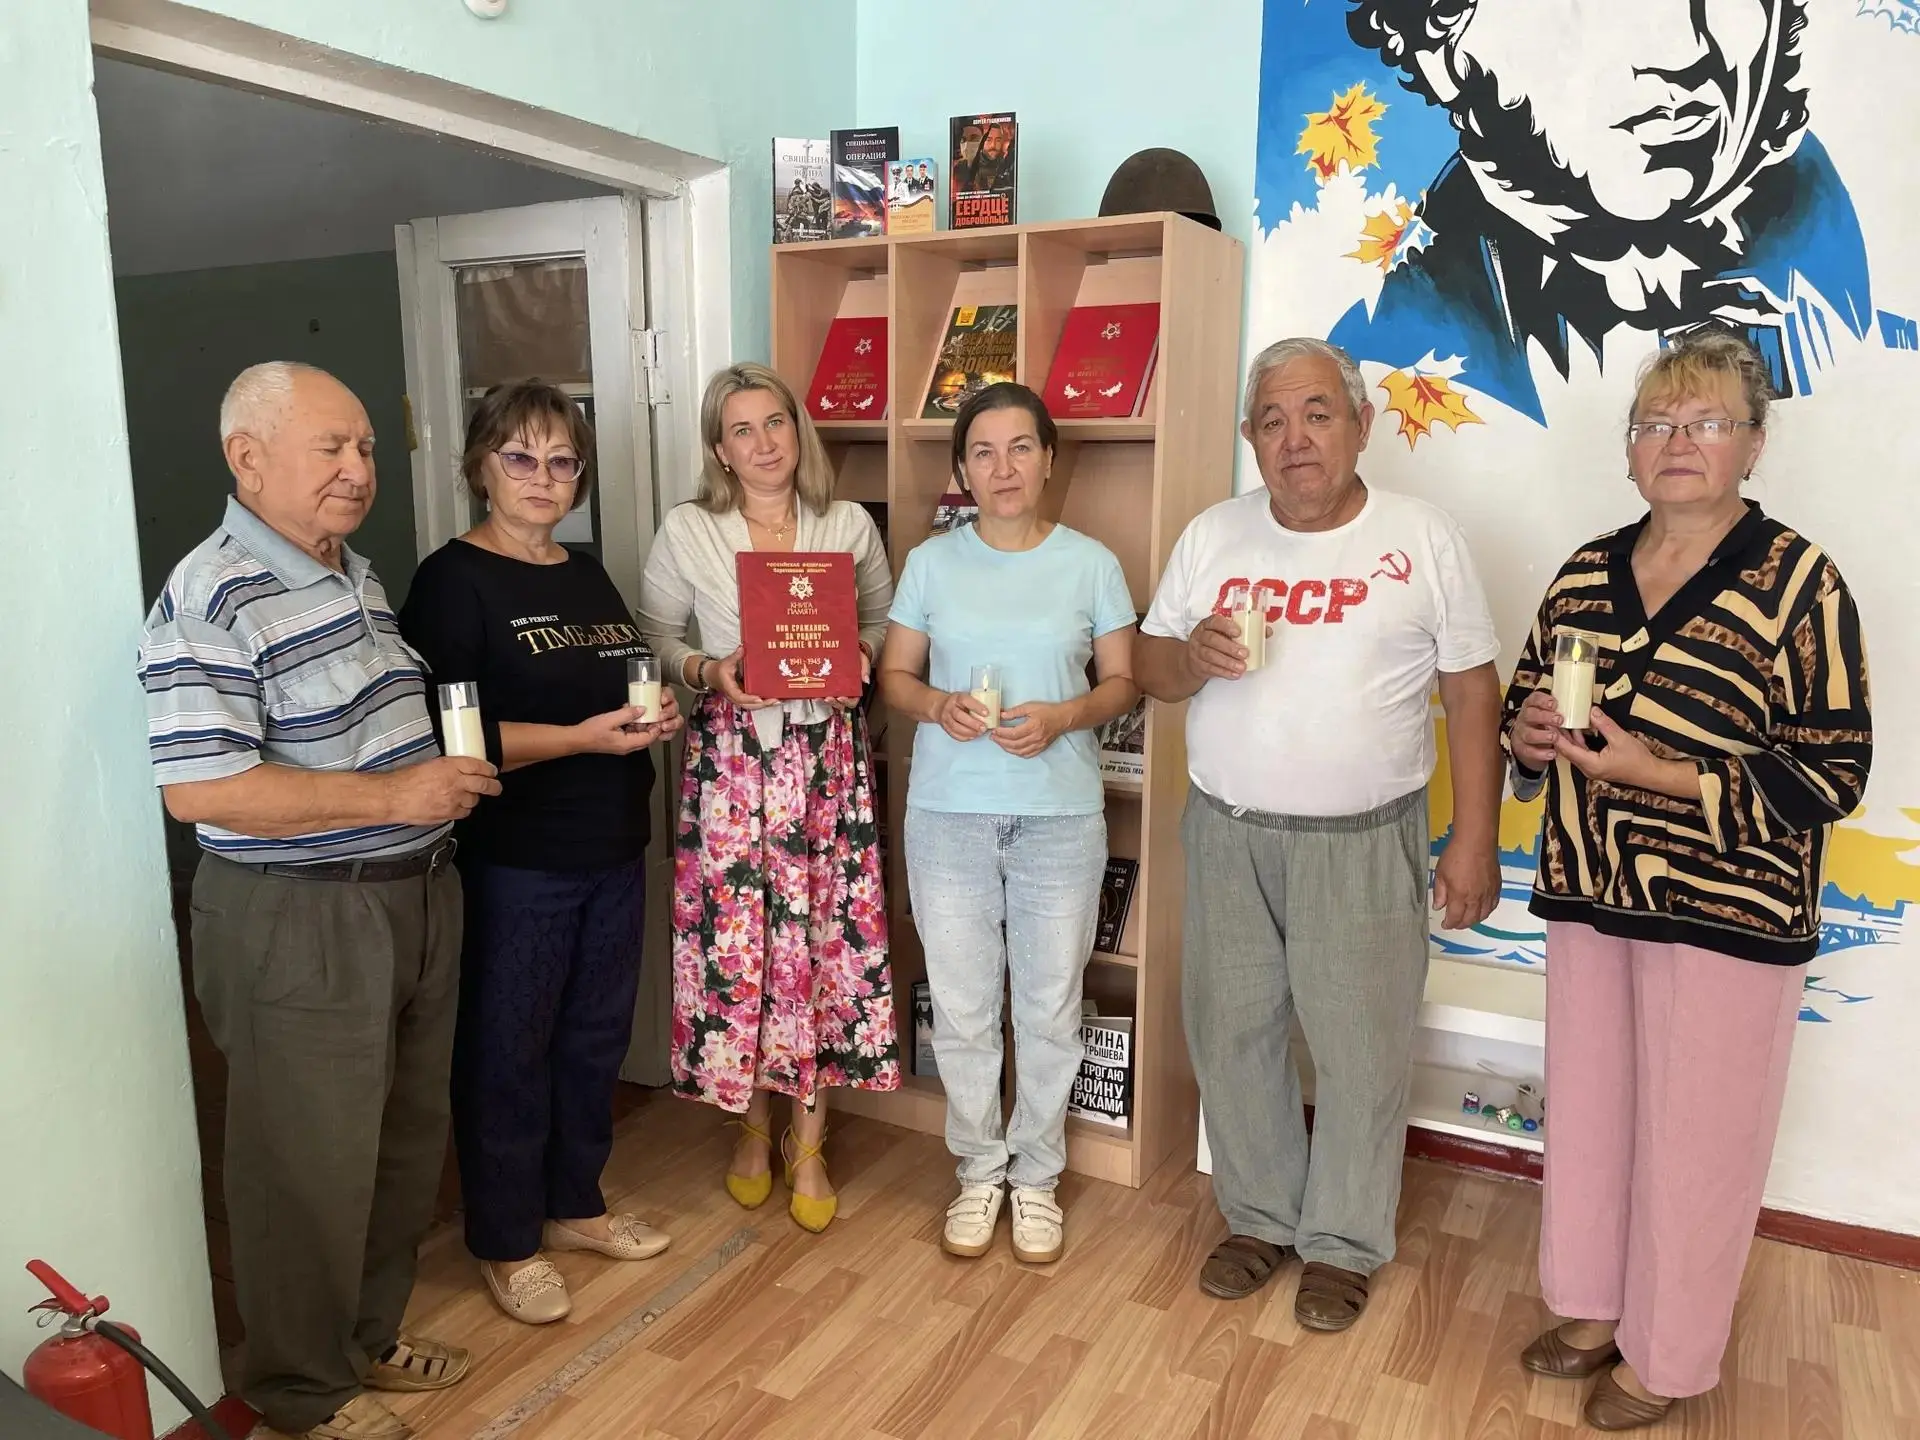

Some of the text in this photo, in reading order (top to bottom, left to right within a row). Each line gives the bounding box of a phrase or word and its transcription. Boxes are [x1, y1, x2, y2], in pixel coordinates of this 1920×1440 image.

[845, 139, 886, 147] СПЕЦИАЛЬНАЯ
[782, 154, 829, 165] СВЯЩЕННА
[846, 152, 886, 161] ОПЕРАЦИЯ
[956, 197, 1009, 216] СЕРДЦЕ
[955, 214, 1009, 227] ДОБРОВОЛЬЦА
[1212, 577, 1368, 625] СССР
[510, 614, 560, 628] THE PERFECT
[517, 625, 592, 655] TIME
[605, 648, 626, 657] WHEN
[626, 647, 634, 655] IT
[1083, 1062, 1124, 1082] ТРОГАЮ
[1074, 1076, 1125, 1099] ВОЙНУ
[1073, 1090, 1124, 1114] РУКАМИ
